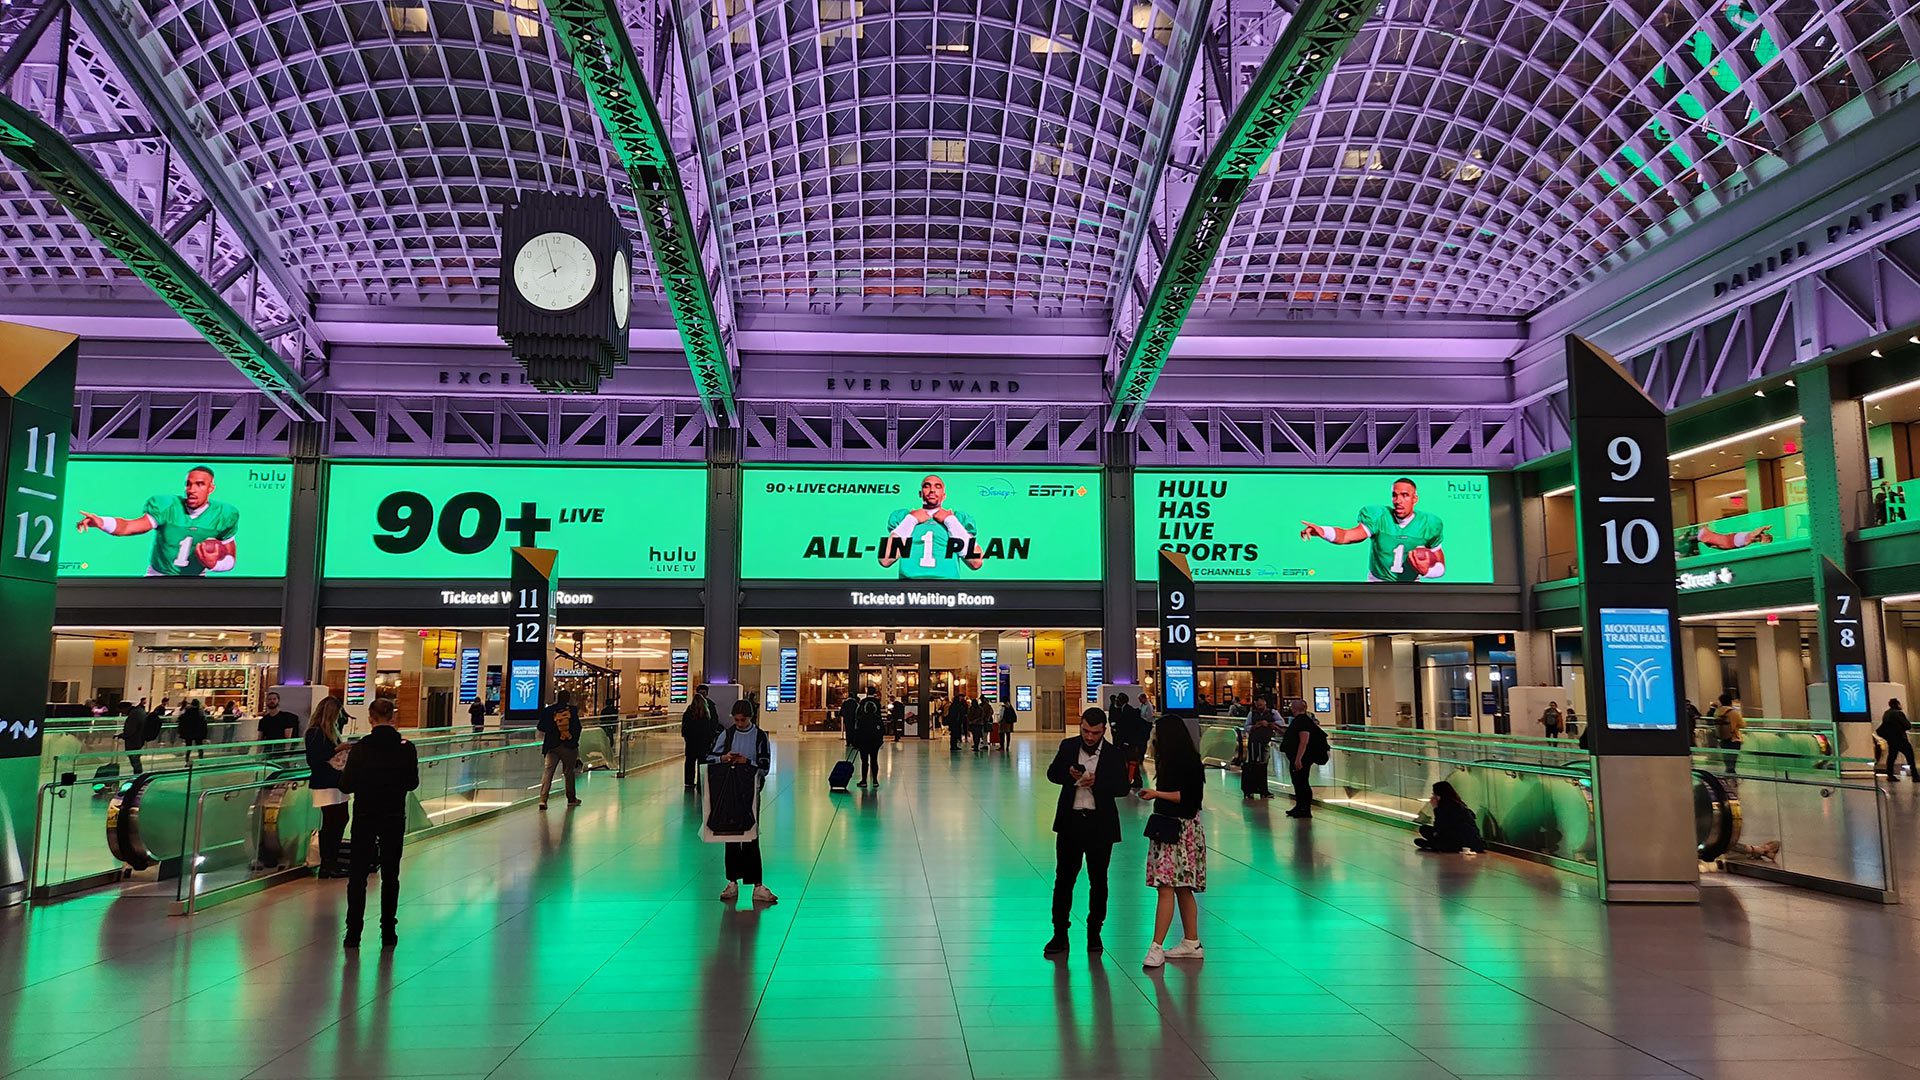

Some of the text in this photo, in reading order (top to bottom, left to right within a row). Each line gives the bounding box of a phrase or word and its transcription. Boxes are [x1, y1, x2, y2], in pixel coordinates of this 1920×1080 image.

[440, 372, 528, 385] EXCEL
[827, 378, 1020, 393] EVER UPWARD
[24, 426, 56, 478] 11
[1608, 436, 1641, 481] 9
[249, 469, 286, 481] hulu
[1158, 480, 1228, 498] HULU
[1448, 480, 1482, 492] hulu
[1158, 501, 1210, 519] HAS
[372, 490, 605, 554] 90+ LIVE
[1159, 522, 1214, 540] LIVE
[14, 512, 54, 563] 12
[1600, 518, 1660, 564] 10
[174, 536, 193, 567] 1
[650, 546, 696, 562] hulu
[802, 530, 1030, 567] ALL-IN 1 PLAN
[1391, 544, 1404, 573] 1
[1680, 571, 1717, 590] Street
[441, 590, 498, 604] Ticketed
[556, 591, 593, 604] Room
[518, 588, 538, 608] 11
[851, 591, 994, 607] Ticketed Waiting Room
[1170, 591, 1185, 610] 9
[1837, 595, 1850, 614] 7
[516, 622, 540, 643] 12
[1166, 624, 1191, 644] 10
[1604, 624, 1666, 633] MOYNIHAN
[1604, 633, 1667, 642] TRAIN HALL
[1841, 628, 1855, 647] 8
[201, 653, 238, 662] CREAM
